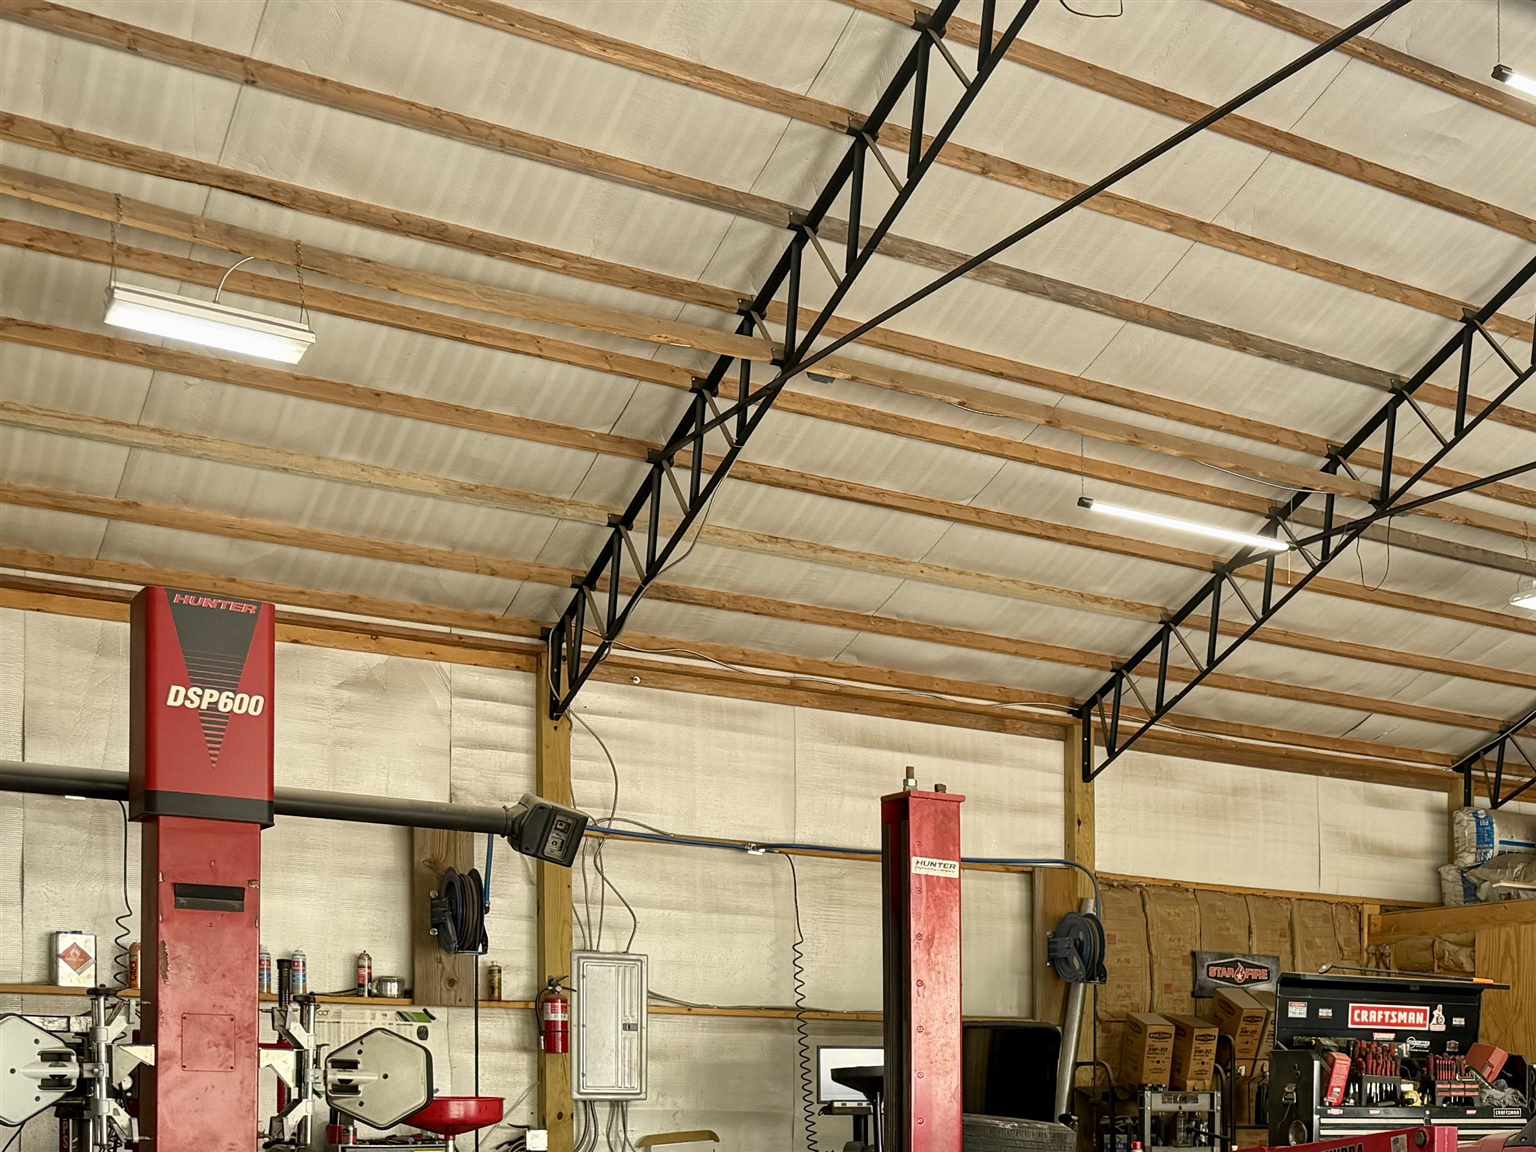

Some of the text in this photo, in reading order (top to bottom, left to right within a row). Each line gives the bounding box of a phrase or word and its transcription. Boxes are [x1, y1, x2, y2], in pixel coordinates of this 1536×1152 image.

[173, 593, 257, 614] HUNTER
[166, 684, 265, 716] DSP600
[915, 860, 956, 870] HUNTER
[1208, 966, 1234, 978] STAR
[1353, 1009, 1424, 1025] CRAFTSMAN
